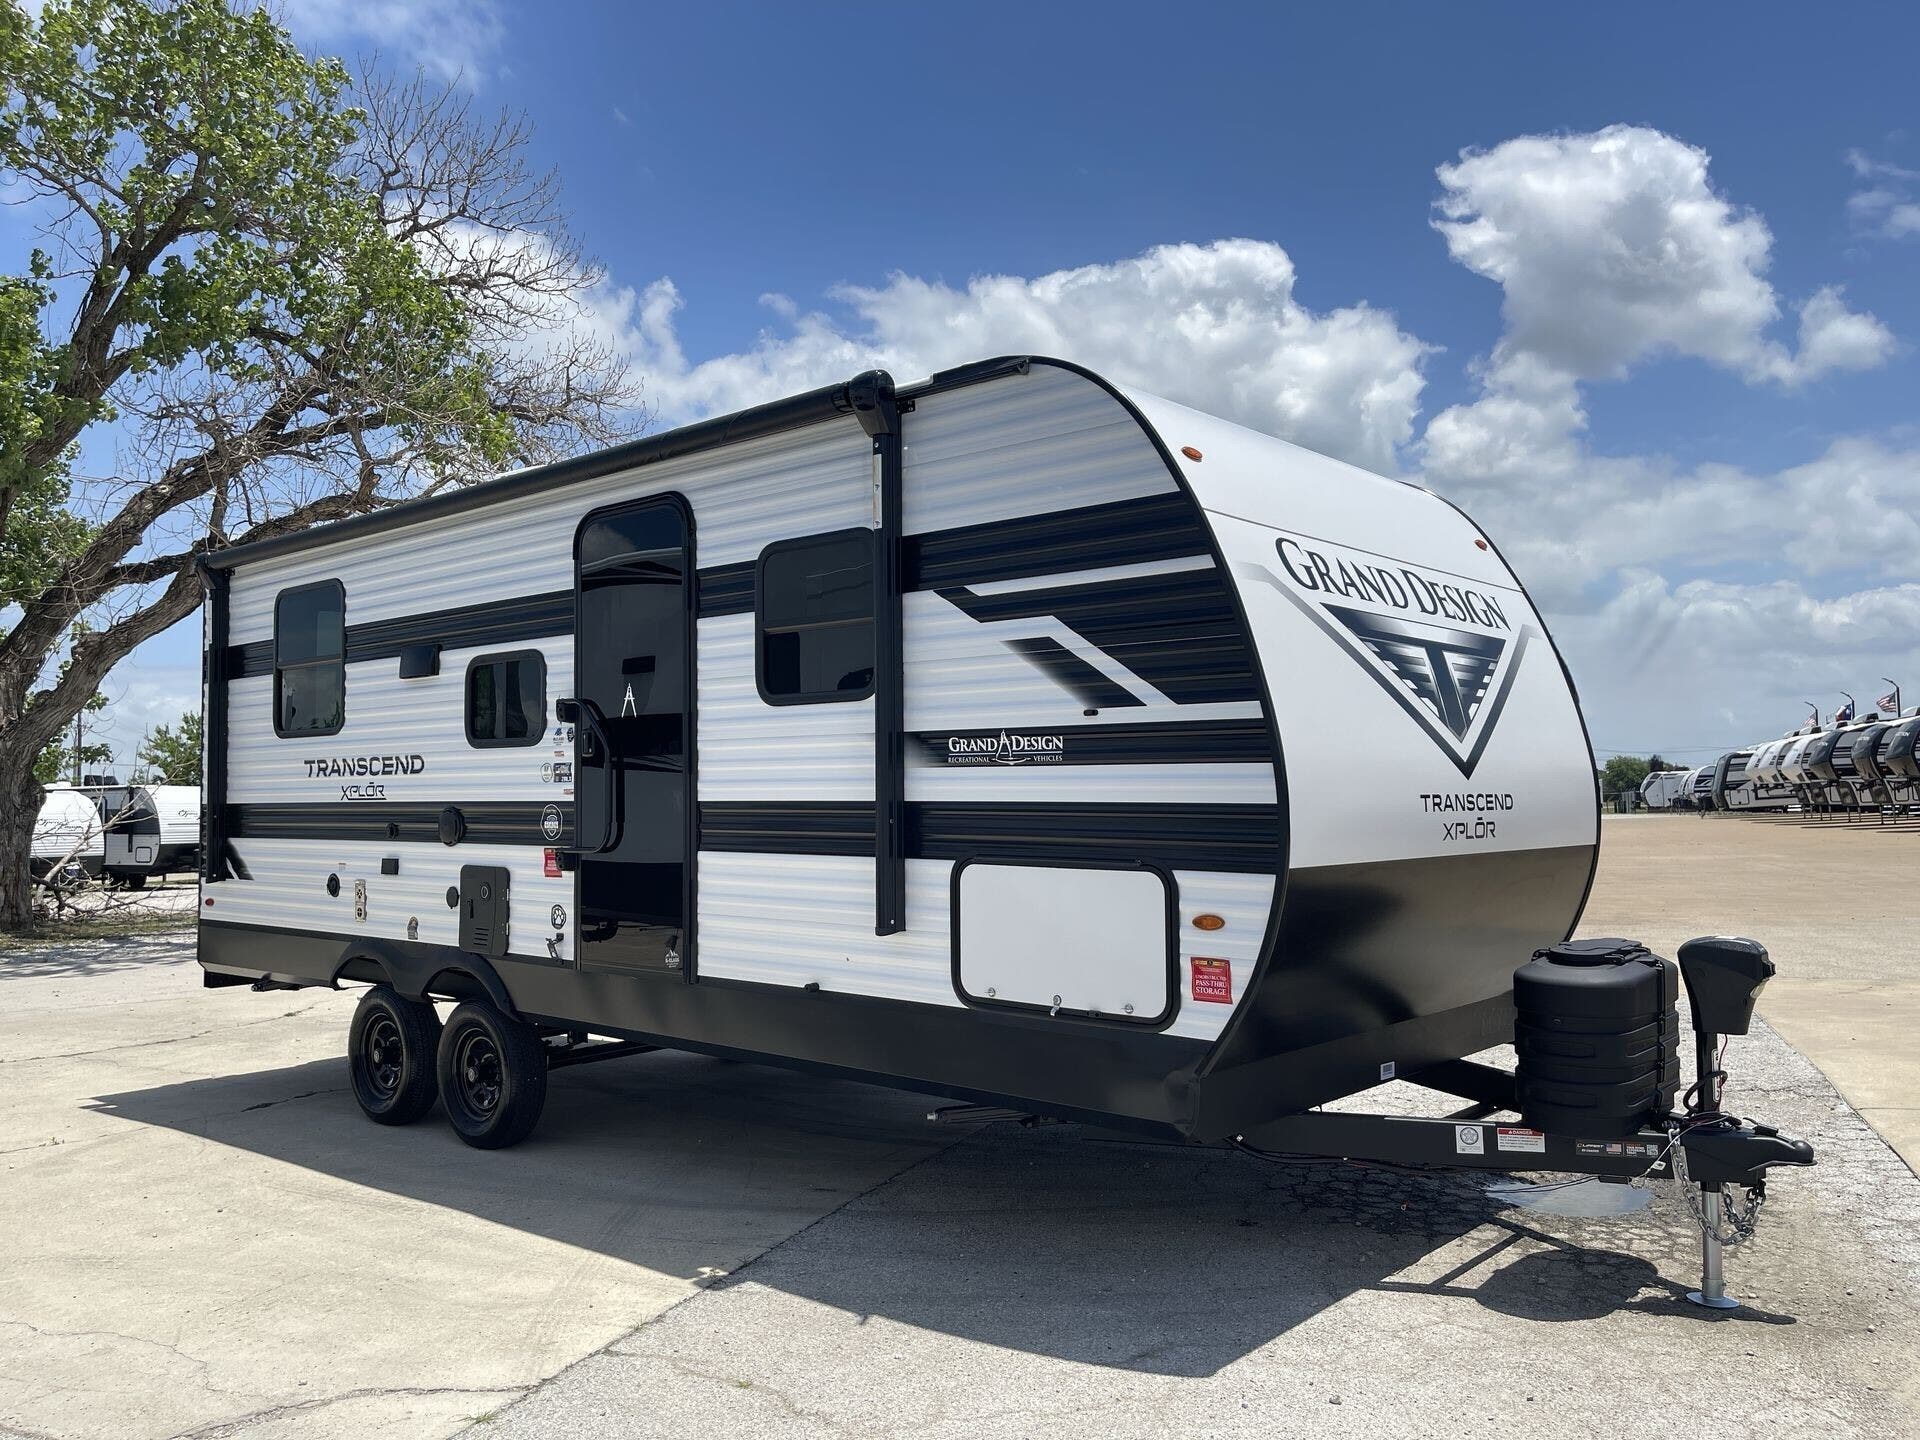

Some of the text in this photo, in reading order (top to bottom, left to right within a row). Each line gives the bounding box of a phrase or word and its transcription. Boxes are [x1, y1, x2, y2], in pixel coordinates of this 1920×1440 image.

[1275, 537, 1512, 632] GRAND DESIGN
[948, 735, 1063, 752] GRAND DESIGN
[304, 754, 425, 778] TRANSCEND
[948, 756, 990, 764] RECREATIONAL
[1420, 793, 1514, 813] TRANSCEND
[1195, 987, 1227, 996] STORAGE
